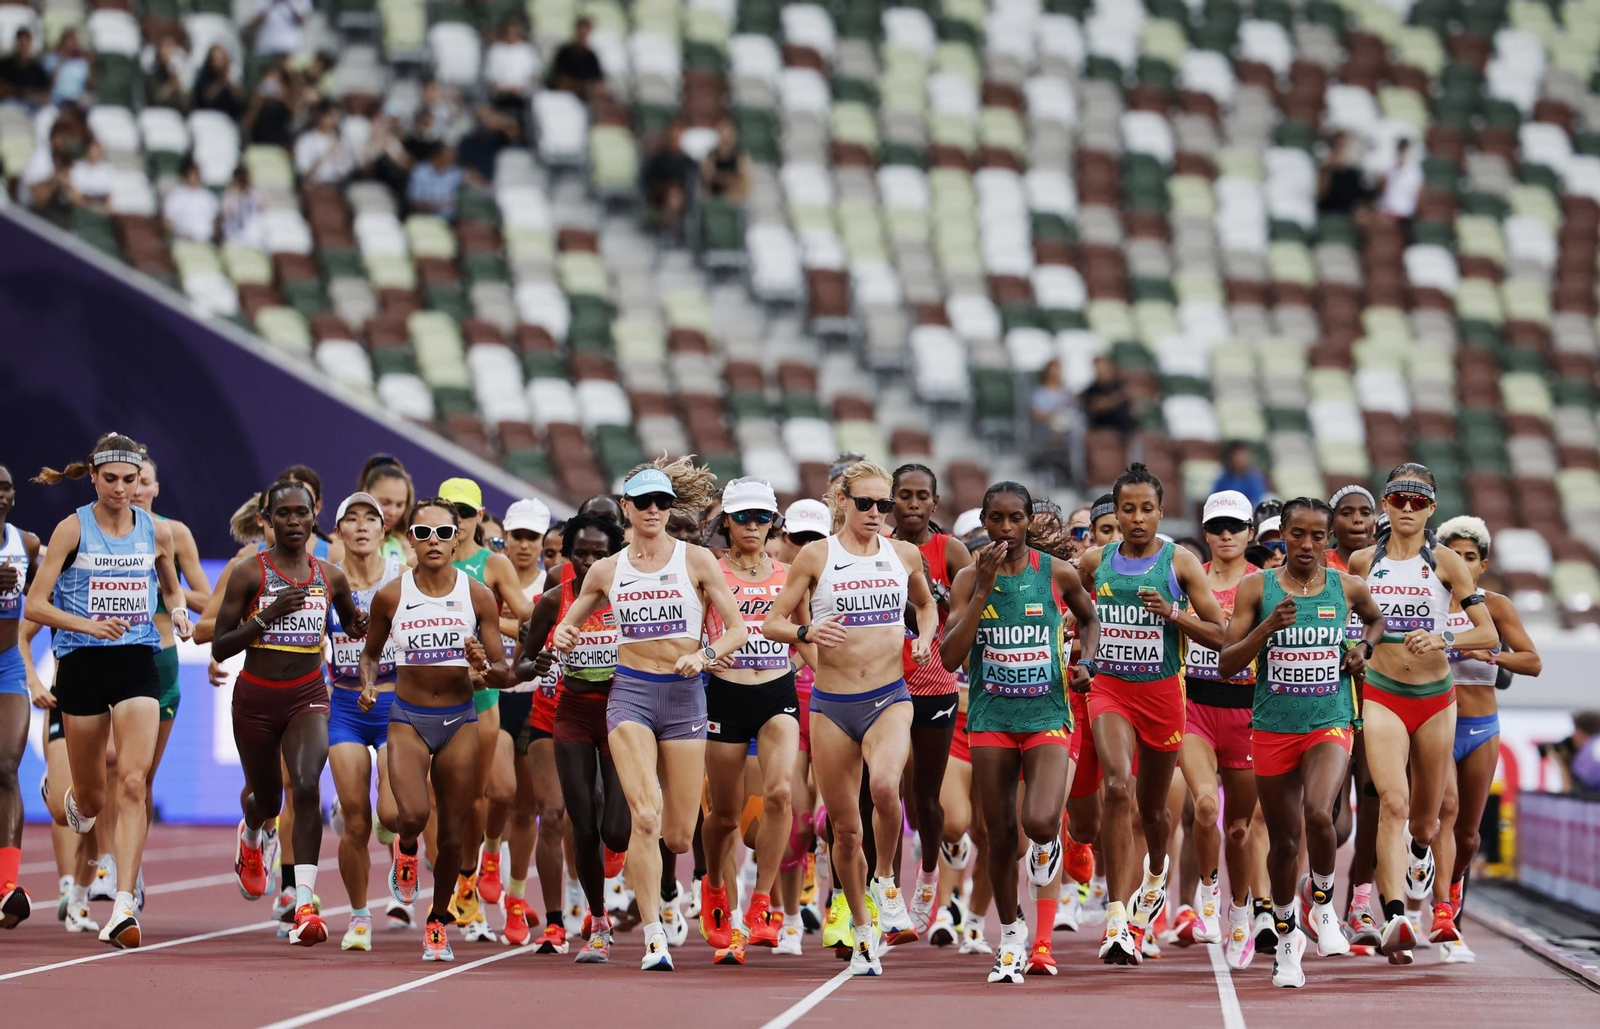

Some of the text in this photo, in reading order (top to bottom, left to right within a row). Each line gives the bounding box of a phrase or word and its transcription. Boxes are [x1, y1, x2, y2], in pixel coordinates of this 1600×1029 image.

[641, 472, 666, 483] USA
[1211, 498, 1237, 508] CHINA
[94, 558, 145, 567] URUGUAY
[91, 581, 148, 591] HONDA
[832, 579, 900, 592] HONDA
[1370, 585, 1433, 596] HONDA
[616, 589, 683, 602] HONDA
[836, 592, 900, 612] SULLIVAN
[261, 601, 325, 611] HDA
[737, 600, 775, 615] APA
[1379, 601, 1430, 617] ZABÓ
[620, 604, 683, 623] McCLAIN
[401, 617, 467, 631] HONDA
[1387, 620, 1432, 628] OKYO25
[976, 624, 1050, 645] ETHIOPIA
[1100, 627, 1161, 640] HONDA
[408, 632, 460, 649] KEMP
[567, 649, 618, 666] JEPCHIRCH
[984, 650, 1049, 663] HONDA
[1096, 643, 1160, 661] KETEMA
[1190, 649, 1217, 665] CIR
[1269, 650, 1338, 662] HONDA
[986, 665, 1048, 684] ASSEFA
[1272, 665, 1336, 683] KEBEDE
